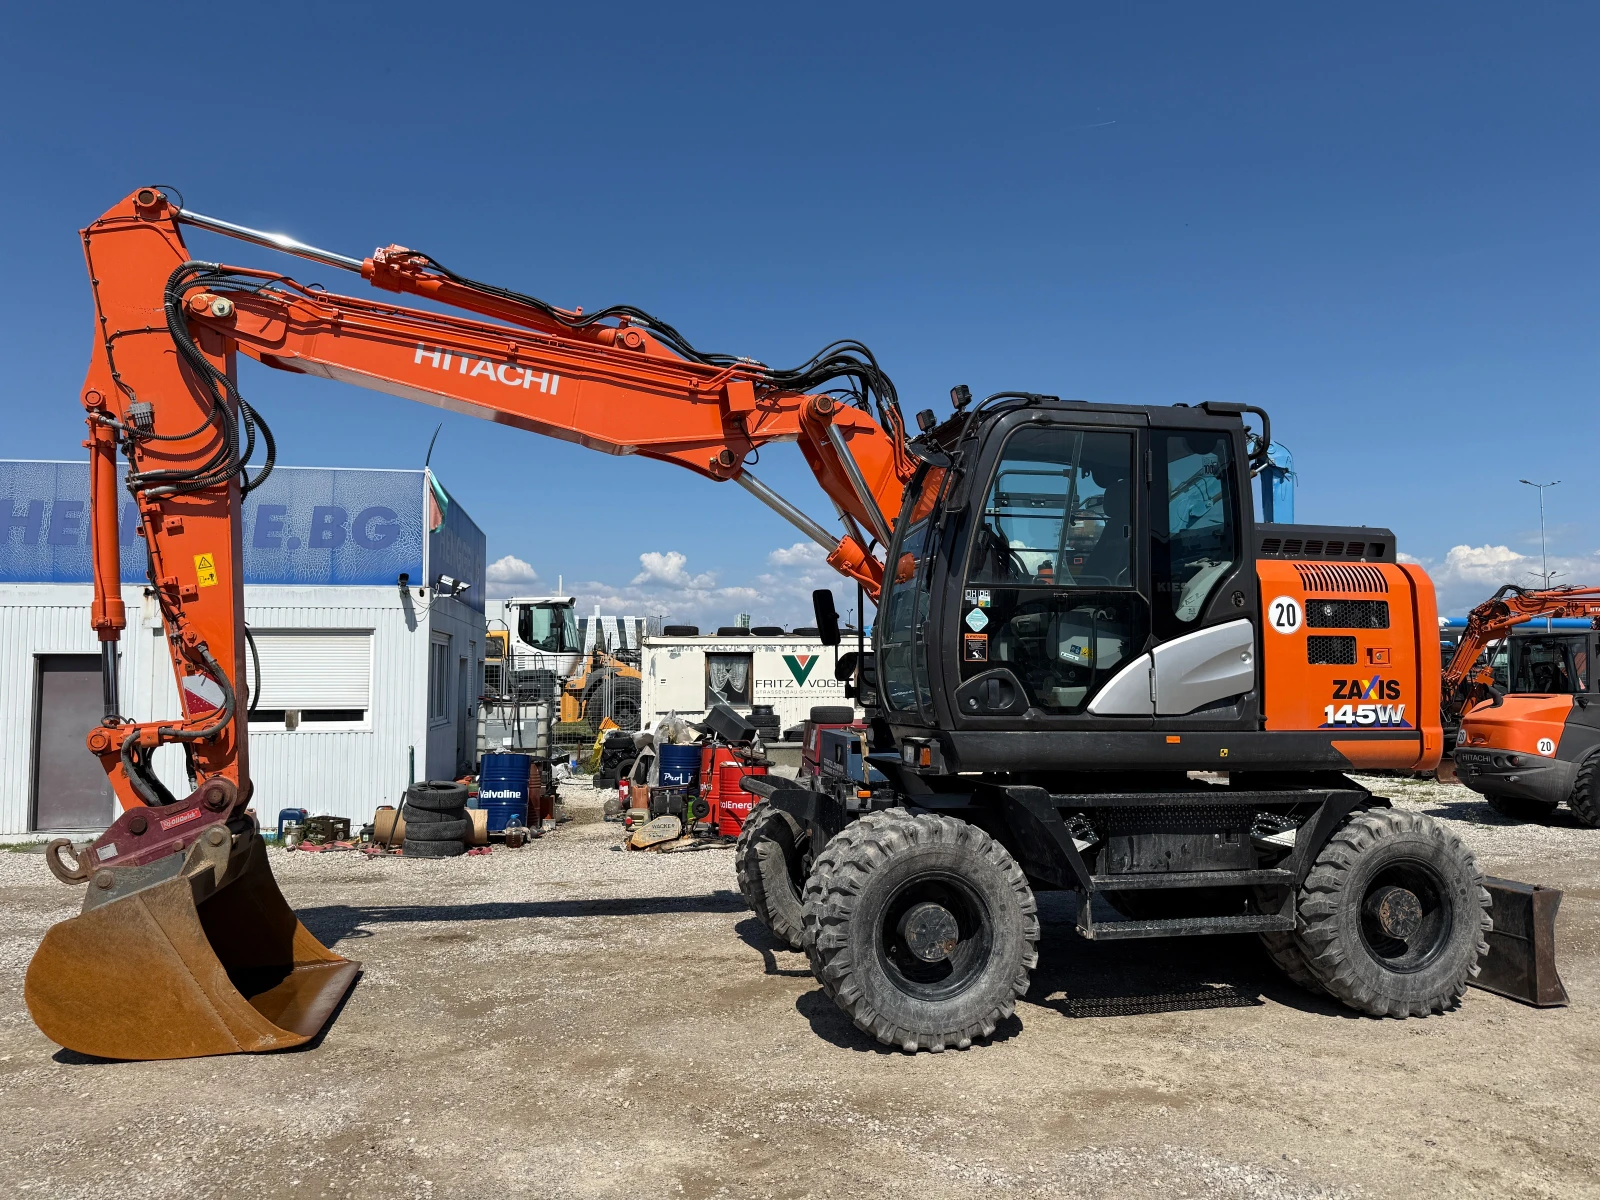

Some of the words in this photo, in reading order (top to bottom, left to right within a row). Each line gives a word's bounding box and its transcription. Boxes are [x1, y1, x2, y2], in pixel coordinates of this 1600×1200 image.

[414, 342, 560, 395] HITACHI
[1275, 603, 1296, 627] 20
[755, 679, 794, 688] FRITZ
[808, 679, 845, 688] VOGE
[1332, 675, 1401, 700] ZAXIS
[1324, 703, 1406, 726] 145W
[1540, 741, 1552, 752] 20
[1462, 753, 1491, 763] HITACHI
[479, 789, 522, 799] Valvoline
